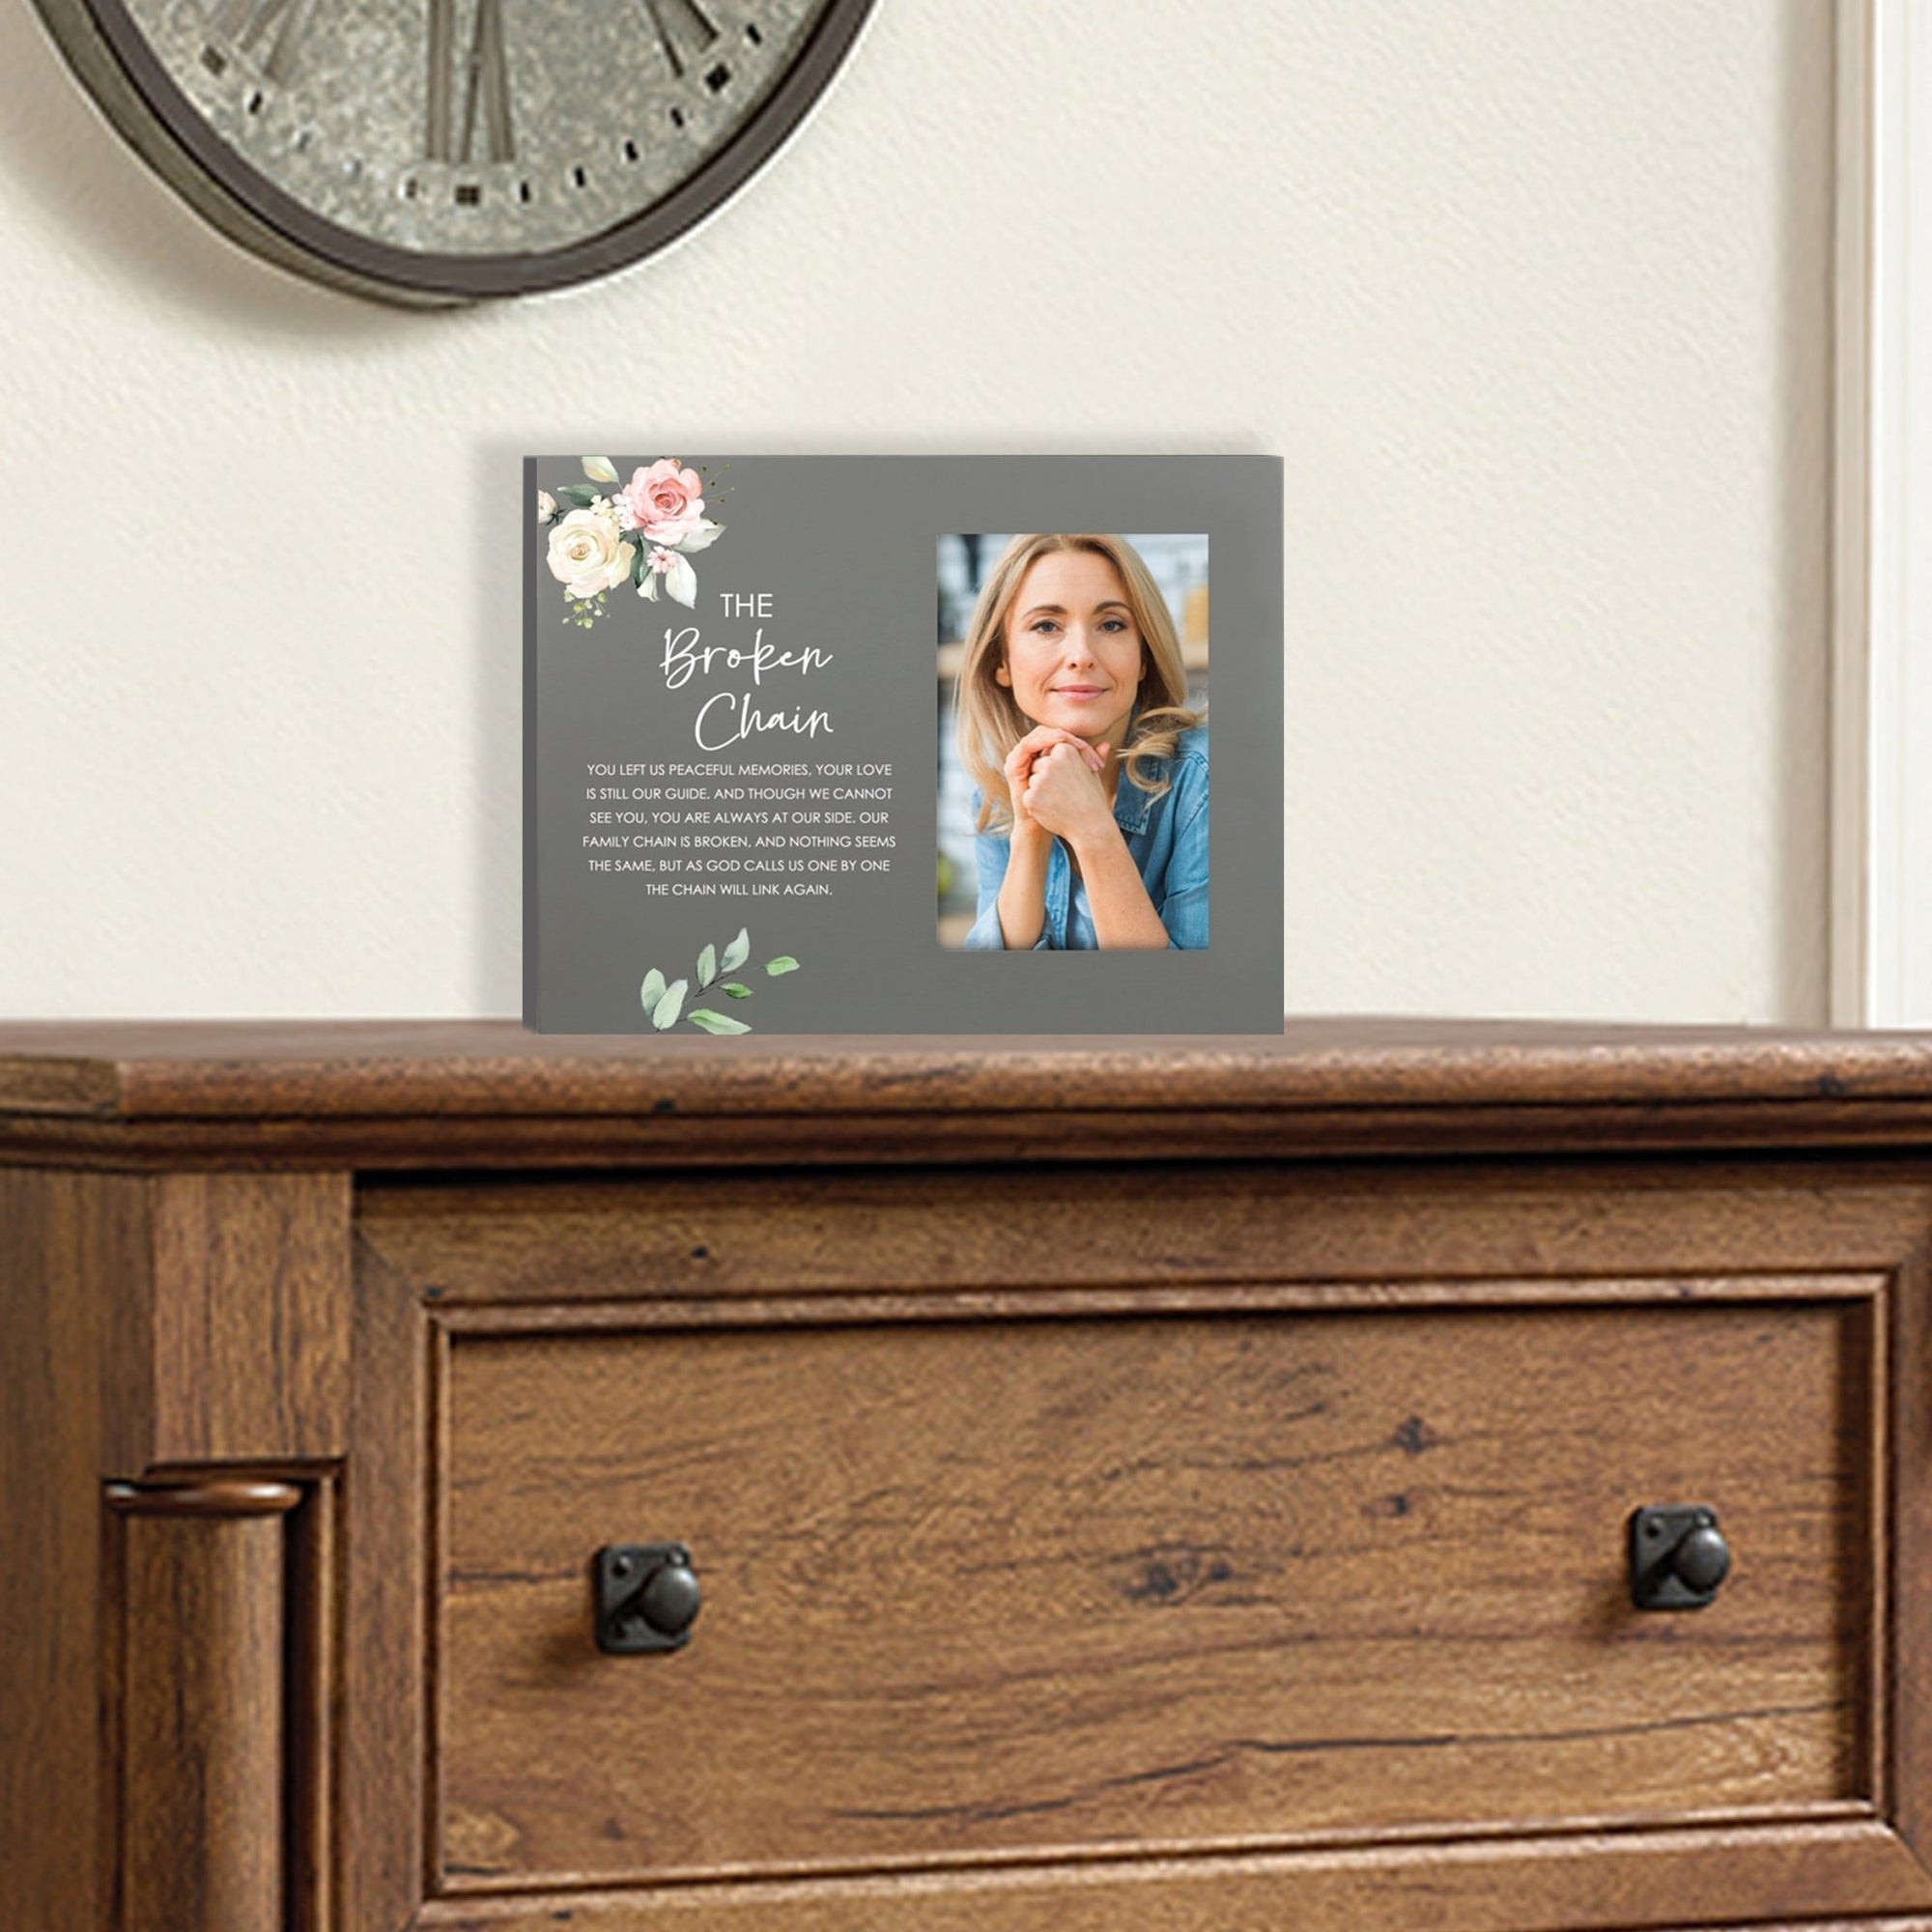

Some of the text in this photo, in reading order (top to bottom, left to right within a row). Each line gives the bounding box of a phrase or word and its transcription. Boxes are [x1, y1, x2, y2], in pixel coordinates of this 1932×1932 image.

[719, 593, 774, 618] THE
[659, 627, 834, 690] Broken
[695, 692, 835, 752] Chain
[586, 763, 893, 777] YOU LEFT US PEACEFUL MEMORIES, YOUR LOVE
[586, 787, 893, 801] IS STILL OUR GUIDE. AND THOUGH WE CANNOT
[589, 811, 890, 825] SEE YOU, YOU ARE ALWAYS AT OUR SIDE. OUR
[582, 835, 896, 848] FAMILY CHAIN IS BROKEN, AND NOTHING SEEMS
[587, 859, 891, 872] THE SAME, BUT AS GOD CALLS US ONE BY ONE
[645, 883, 833, 896] THE CHAIN WILL LINK AGAIN.
